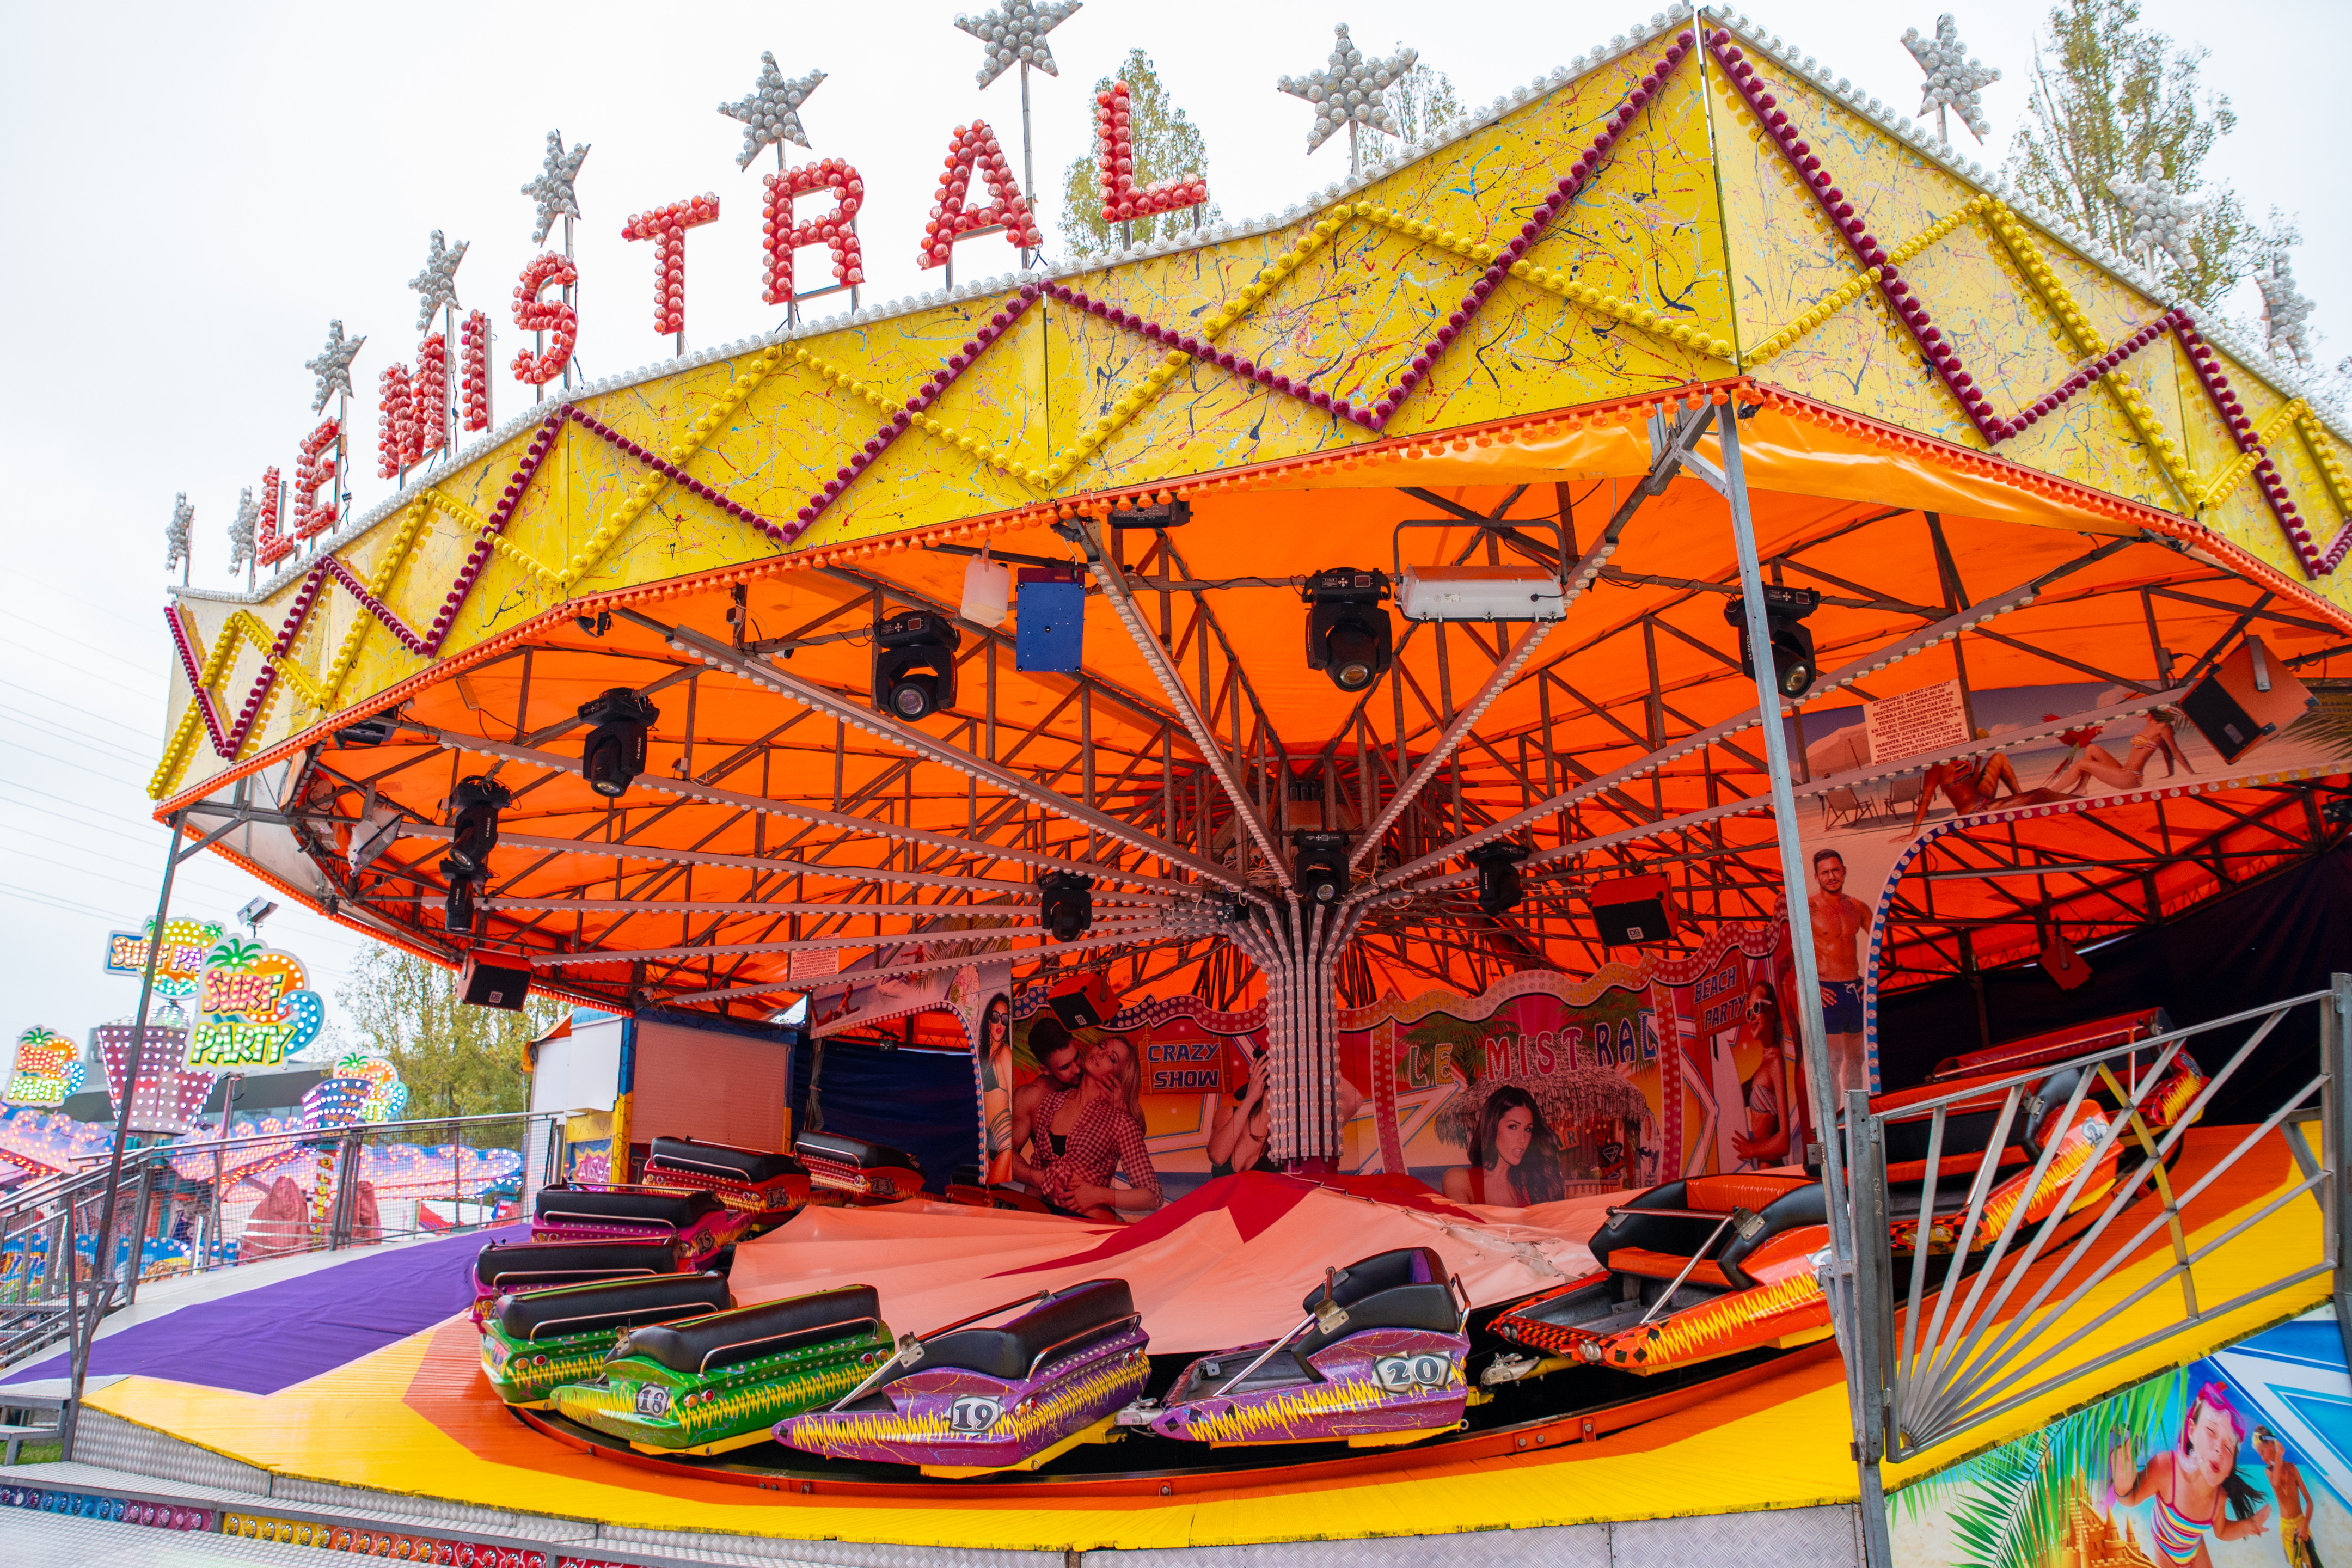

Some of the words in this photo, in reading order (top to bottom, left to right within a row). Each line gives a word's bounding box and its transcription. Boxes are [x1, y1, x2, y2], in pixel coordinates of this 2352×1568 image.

[256, 416, 341, 566] LE
[378, 79, 1208, 480] MISTRAL
[1872, 695, 1900, 706] ATTENDRE
[1901, 688, 1924, 698] L'ARRET
[1925, 681, 1951, 691] COMPLET
[1905, 693, 1928, 702] MONTER
[1915, 694, 1945, 705] DIRECTION
[1875, 712, 1897, 721] POURRA
[1907, 704, 1926, 713] AUCUN
[1878, 718, 1896, 726] TENUE
[1913, 702, 1952, 716] RESPONSABLE
[1898, 714, 1927, 726] CONCERNE
[1940, 706, 1961, 715] OBJETS
[1898, 719, 1932, 731] DETERIORES
[1901, 728, 1919, 736] AUTRE
[1926, 724, 1953, 735] SECURITE
[1901, 750, 1919, 758] VOTRE
[1920, 737, 1968, 753] COMPREHENSION
[1915, 733, 1941, 743] VEUILLEZ
[1877, 746, 1909, 759] STATIONNER
[1911, 740, 1933, 750] DEVANT
[203, 970, 285, 1013] SURF
[1694, 965, 1737, 1004] BEACH
[1704, 993, 1748, 1031] PARTY
[191, 1024, 294, 1064] PARTY
[1147, 1043, 1221, 1062] CRAZY
[1408, 1043, 1453, 1088] LE
[1485, 1013, 1658, 1082] MISTRAL
[17, 1045, 66, 1071] SURF
[7, 1075, 69, 1101] PARTY
[1153, 1069, 1219, 1088] SHOW
[873, 1178, 891, 1191] 13
[767, 1189, 787, 1205] 14
[697, 1230, 713, 1252] 15
[1386, 1356, 1440, 1385] 20
[638, 1389, 664, 1414] 18
[953, 1403, 994, 1430] 19
